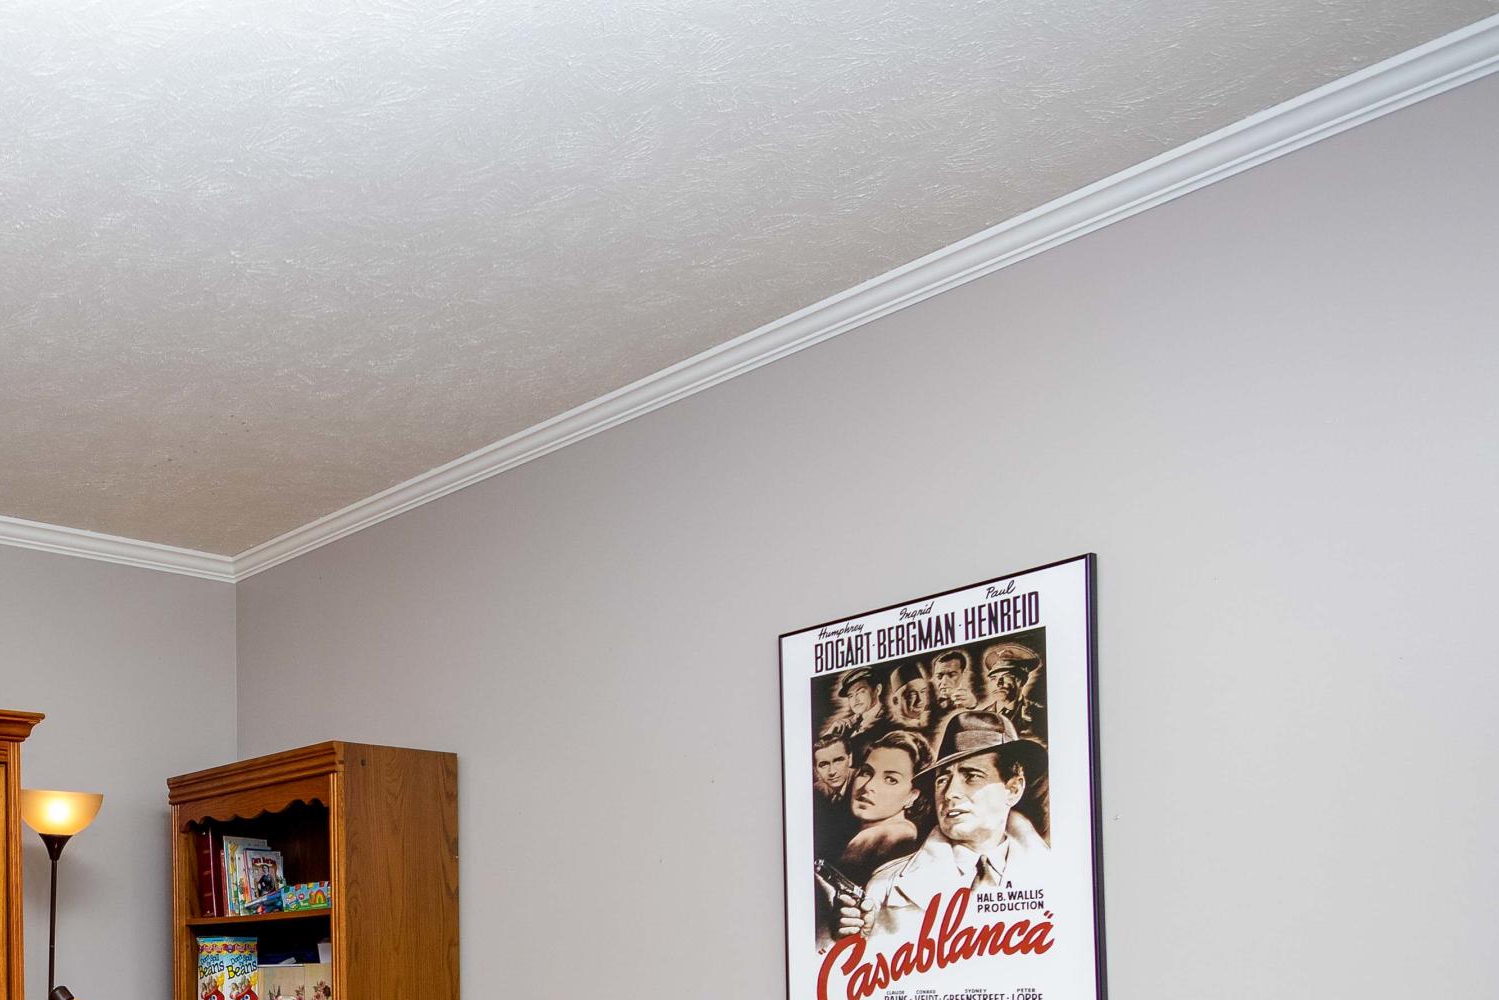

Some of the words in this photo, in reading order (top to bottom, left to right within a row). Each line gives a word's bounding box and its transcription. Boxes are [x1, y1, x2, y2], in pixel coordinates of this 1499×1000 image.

[985, 579, 1016, 600] Paul
[899, 601, 934, 621] Ingrid
[814, 632, 872, 673] BOGART
[876, 612, 956, 661] BERGMAN
[964, 591, 1040, 641] HENREID
[818, 622, 865, 640] Humphrey
[1005, 881, 1013, 889] A
[977, 892, 994, 903] HAL
[997, 891, 1006, 902] B.
[1007, 889, 1044, 900] WALLIS
[977, 900, 1045, 913] PRODUCTION
[226, 960, 258, 980] Beans
